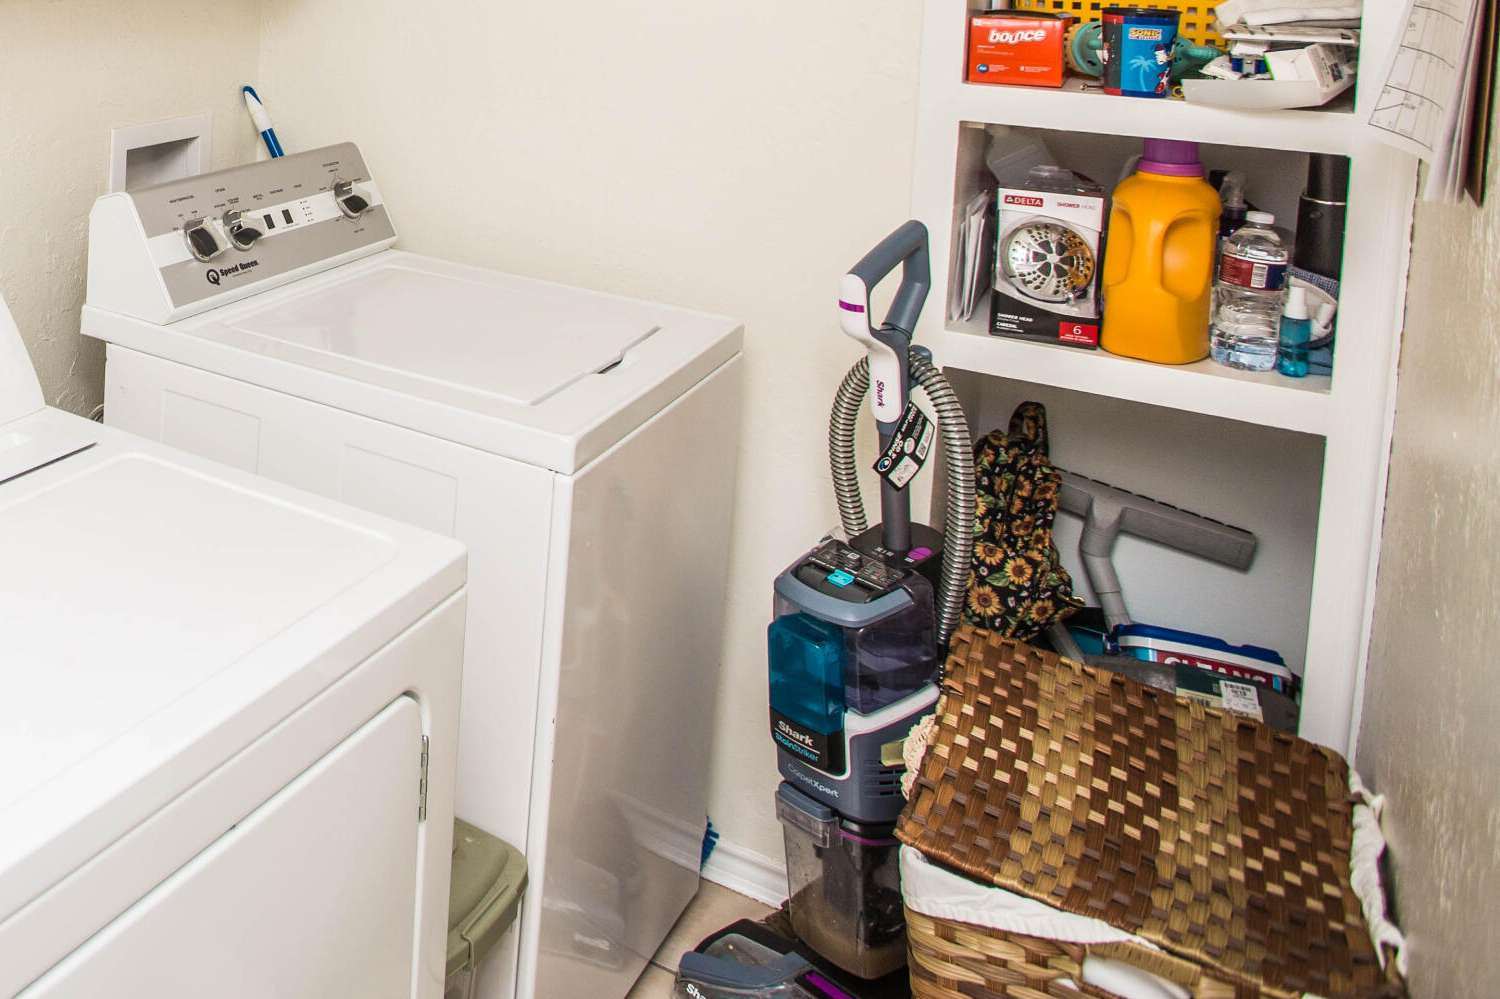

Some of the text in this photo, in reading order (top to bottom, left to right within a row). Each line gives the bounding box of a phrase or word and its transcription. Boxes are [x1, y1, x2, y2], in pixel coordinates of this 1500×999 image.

[989, 29, 1046, 44] bounce
[1130, 28, 1161, 36] SONIC
[1014, 197, 1042, 206] DELTA
[220, 264, 240, 277] Speed
[1073, 325, 1082, 335] 6
[876, 380, 885, 408] Shark
[778, 721, 813, 746] Shark
[787, 763, 839, 798] CarpetXpert
